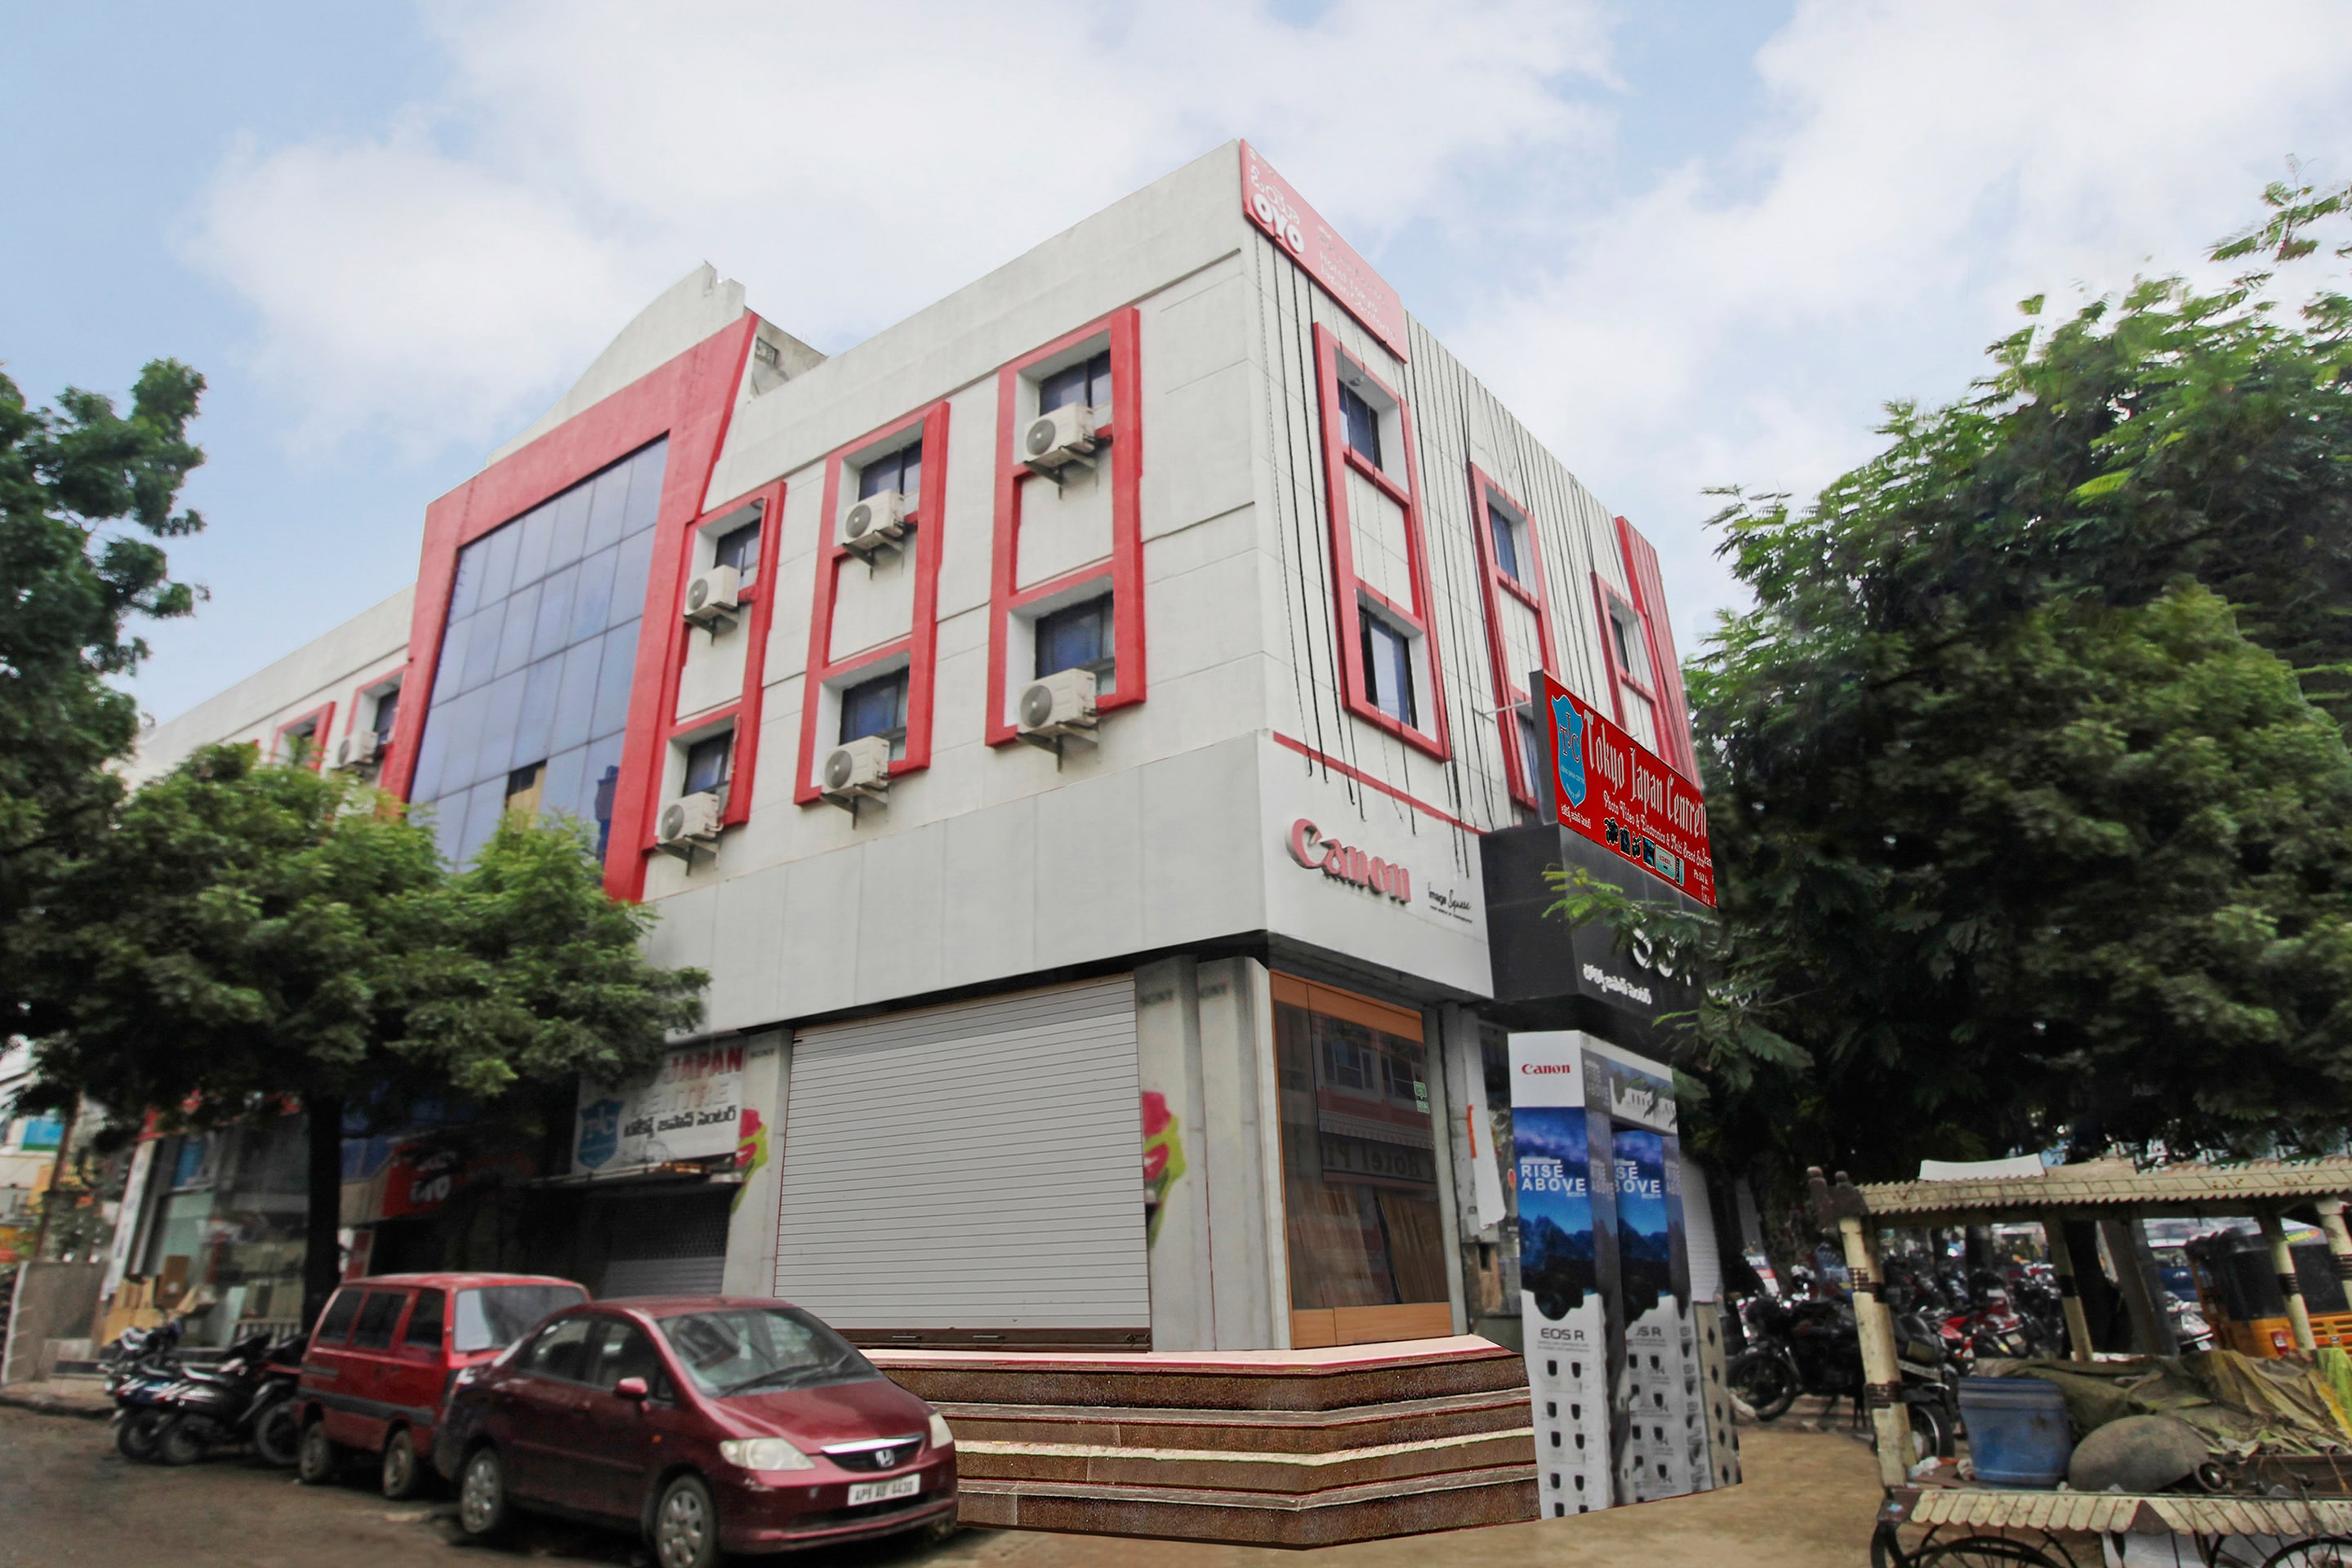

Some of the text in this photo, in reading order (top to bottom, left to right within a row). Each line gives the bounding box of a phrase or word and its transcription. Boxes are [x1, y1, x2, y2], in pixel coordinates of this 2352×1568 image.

[1252, 194, 1304, 254] OYO
[1584, 708, 1625, 795] Tokyo
[1629, 746, 1663, 815] Japan
[1603, 790, 1619, 815] Photo
[1619, 800, 1634, 825] Video
[1641, 814, 1665, 844] Electronics
[1288, 818, 1411, 904] Canon
[1521, 1063, 1570, 1075] Canon
[1521, 1165, 1564, 1178] RISE
[1521, 1178, 1586, 1192] ABOVE
[1540, 1327, 1585, 1341] EOS R
